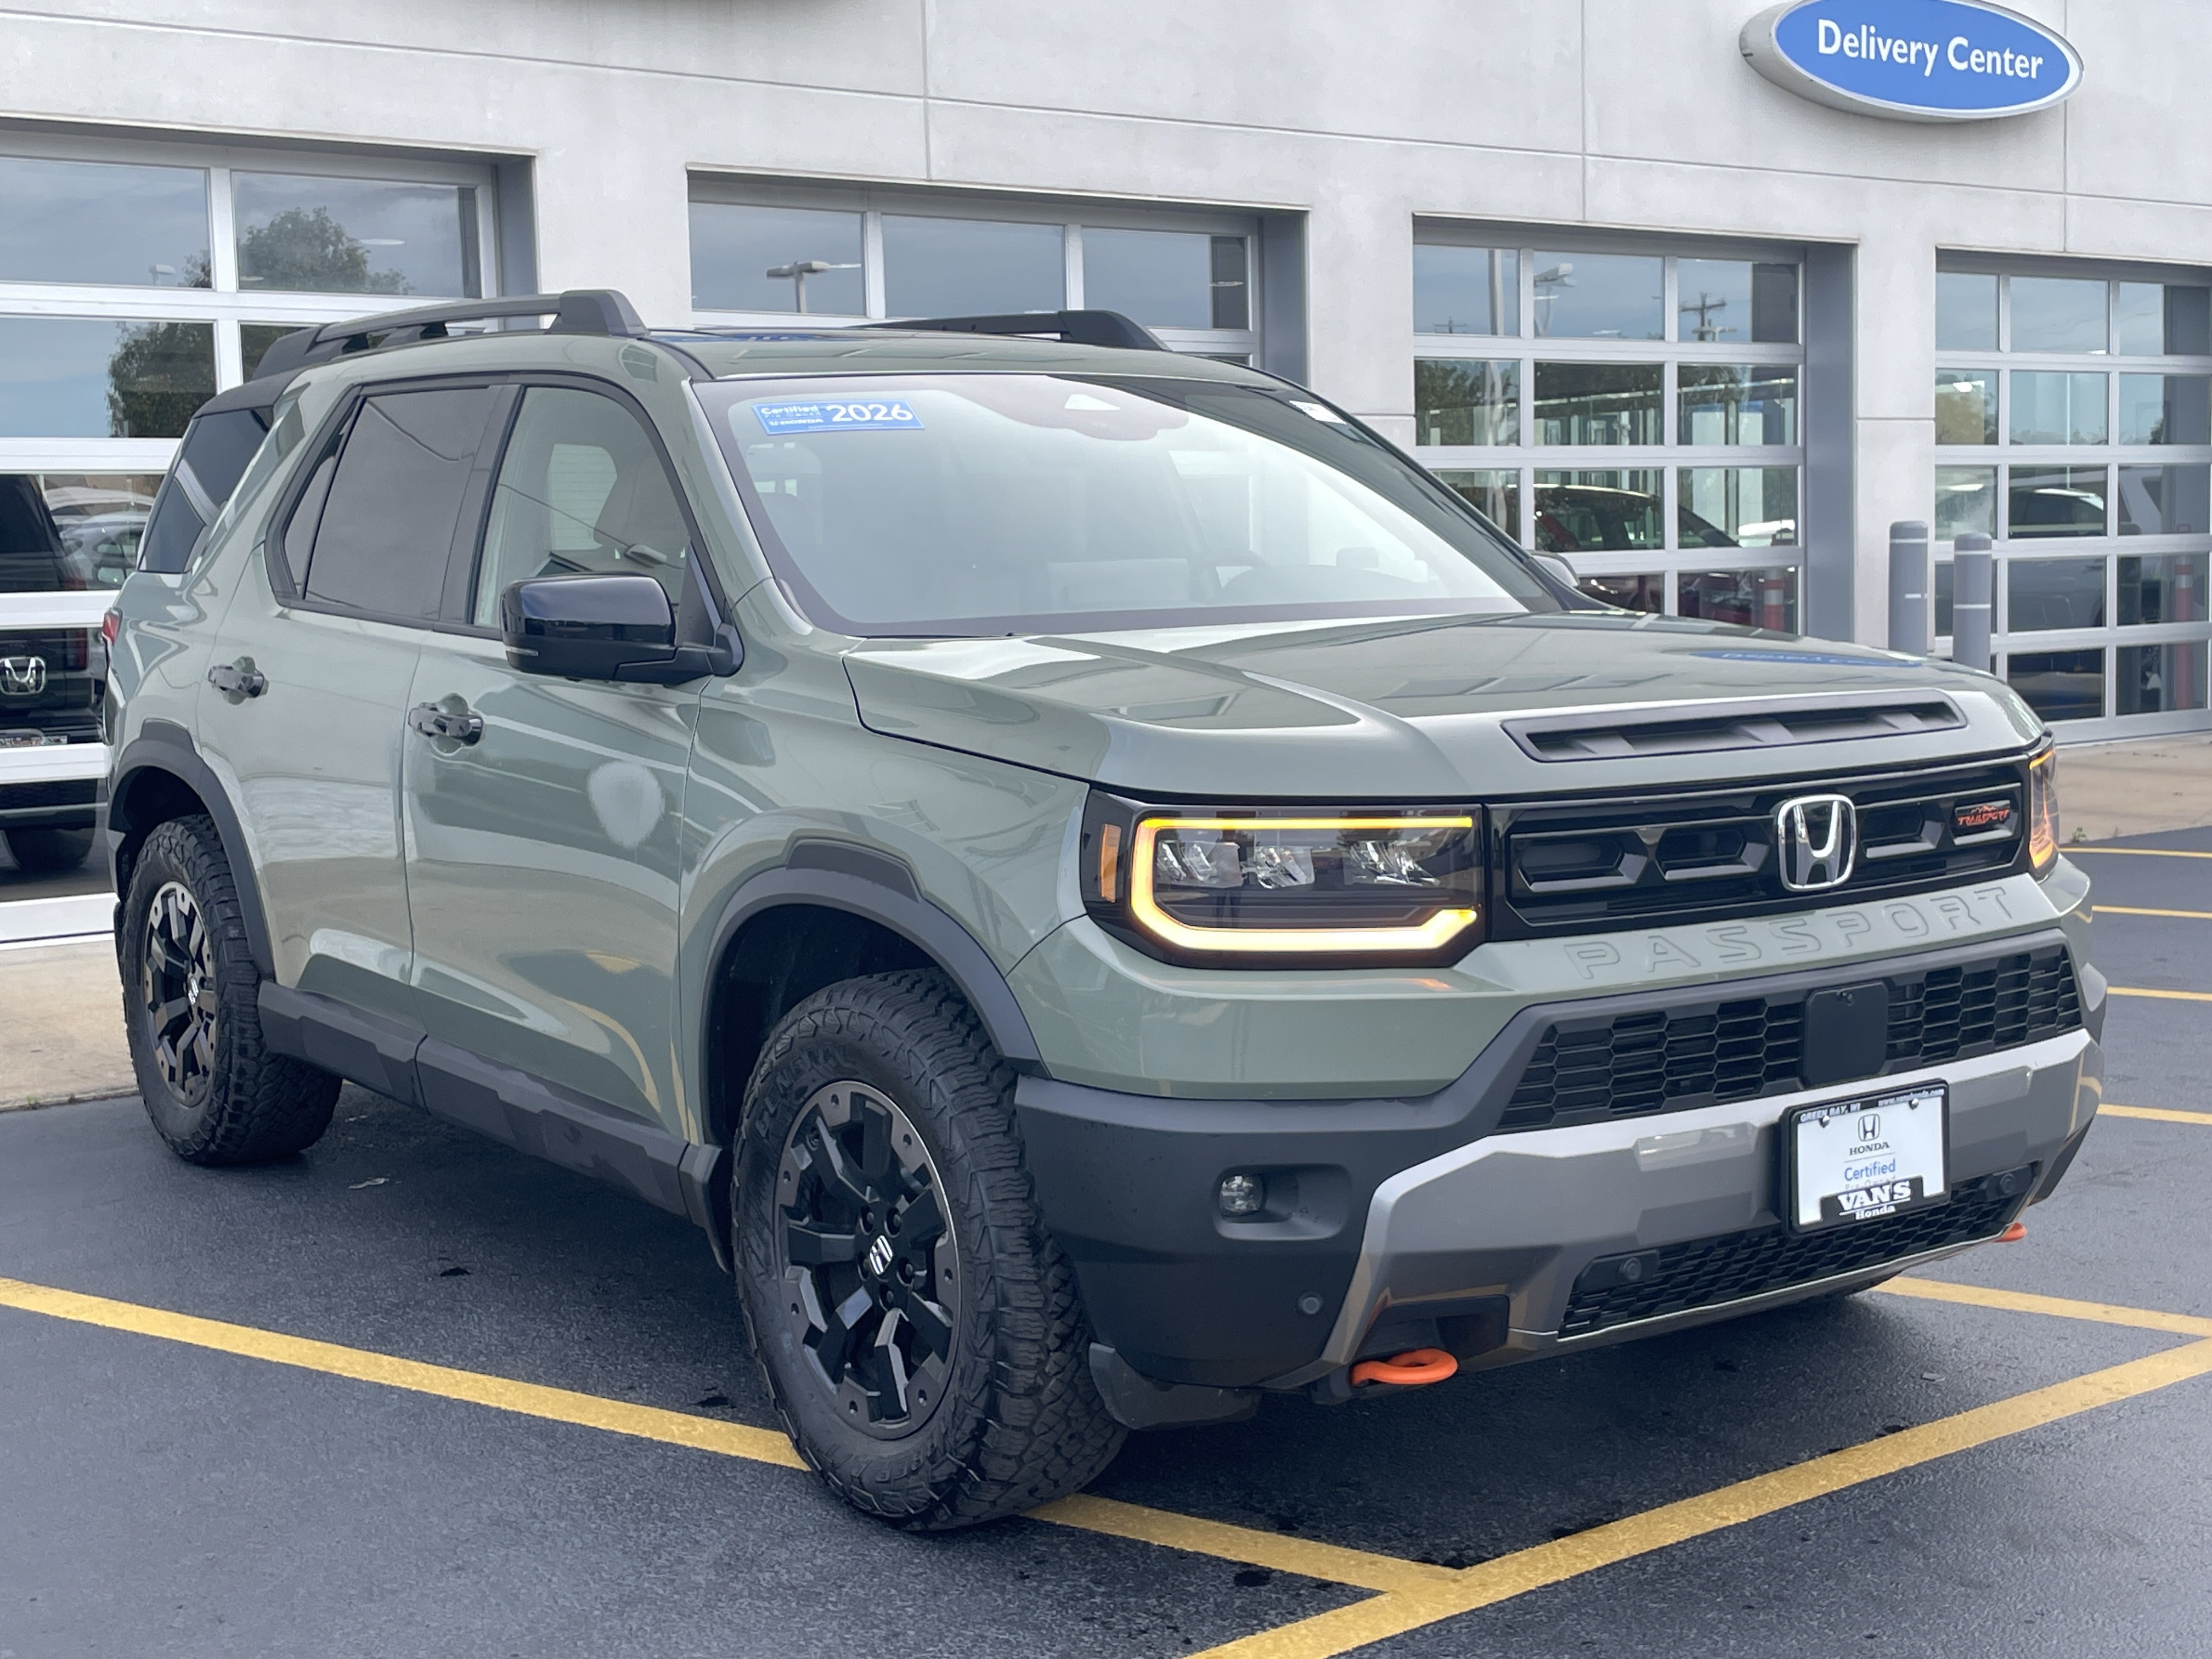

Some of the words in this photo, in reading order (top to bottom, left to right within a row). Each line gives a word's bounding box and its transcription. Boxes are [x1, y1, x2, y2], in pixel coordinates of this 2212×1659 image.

[1818, 19, 1938, 76] Delivery
[1948, 36, 2044, 79] Center
[826, 404, 913, 422] 2026
[1563, 887, 2013, 980] PASSPORT
[1849, 1142, 1890, 1156] HONDA
[1844, 1158, 1896, 1181] Certified
[1855, 1205, 1897, 1220] Honda
